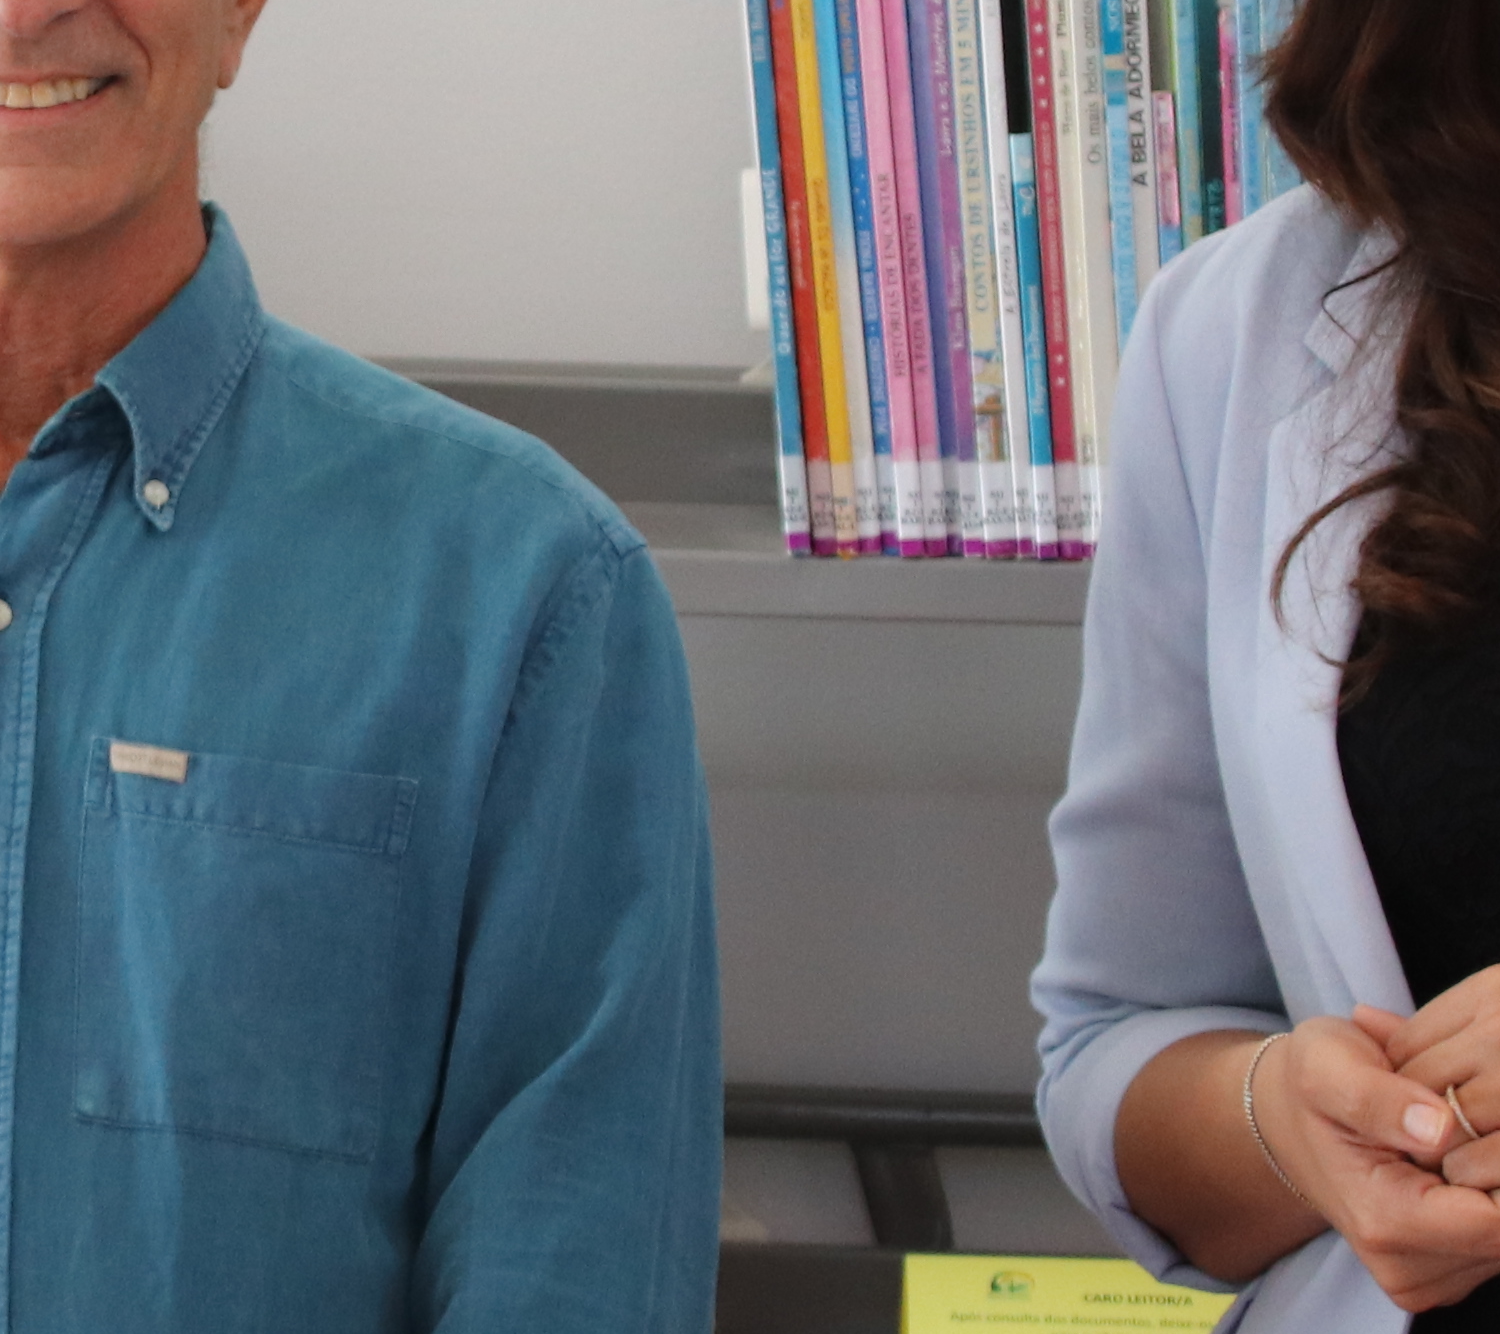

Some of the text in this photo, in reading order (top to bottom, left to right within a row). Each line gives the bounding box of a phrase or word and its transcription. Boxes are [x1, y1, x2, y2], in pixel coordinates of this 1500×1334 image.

[958, 56, 974, 86] EM
[1086, 103, 1099, 137] mais
[1129, 109, 1147, 164] BELA
[1086, 144, 1101, 165] Os
[1132, 171, 1148, 187] A
[964, 201, 982, 226] DE
[966, 233, 989, 312] CONTOS
